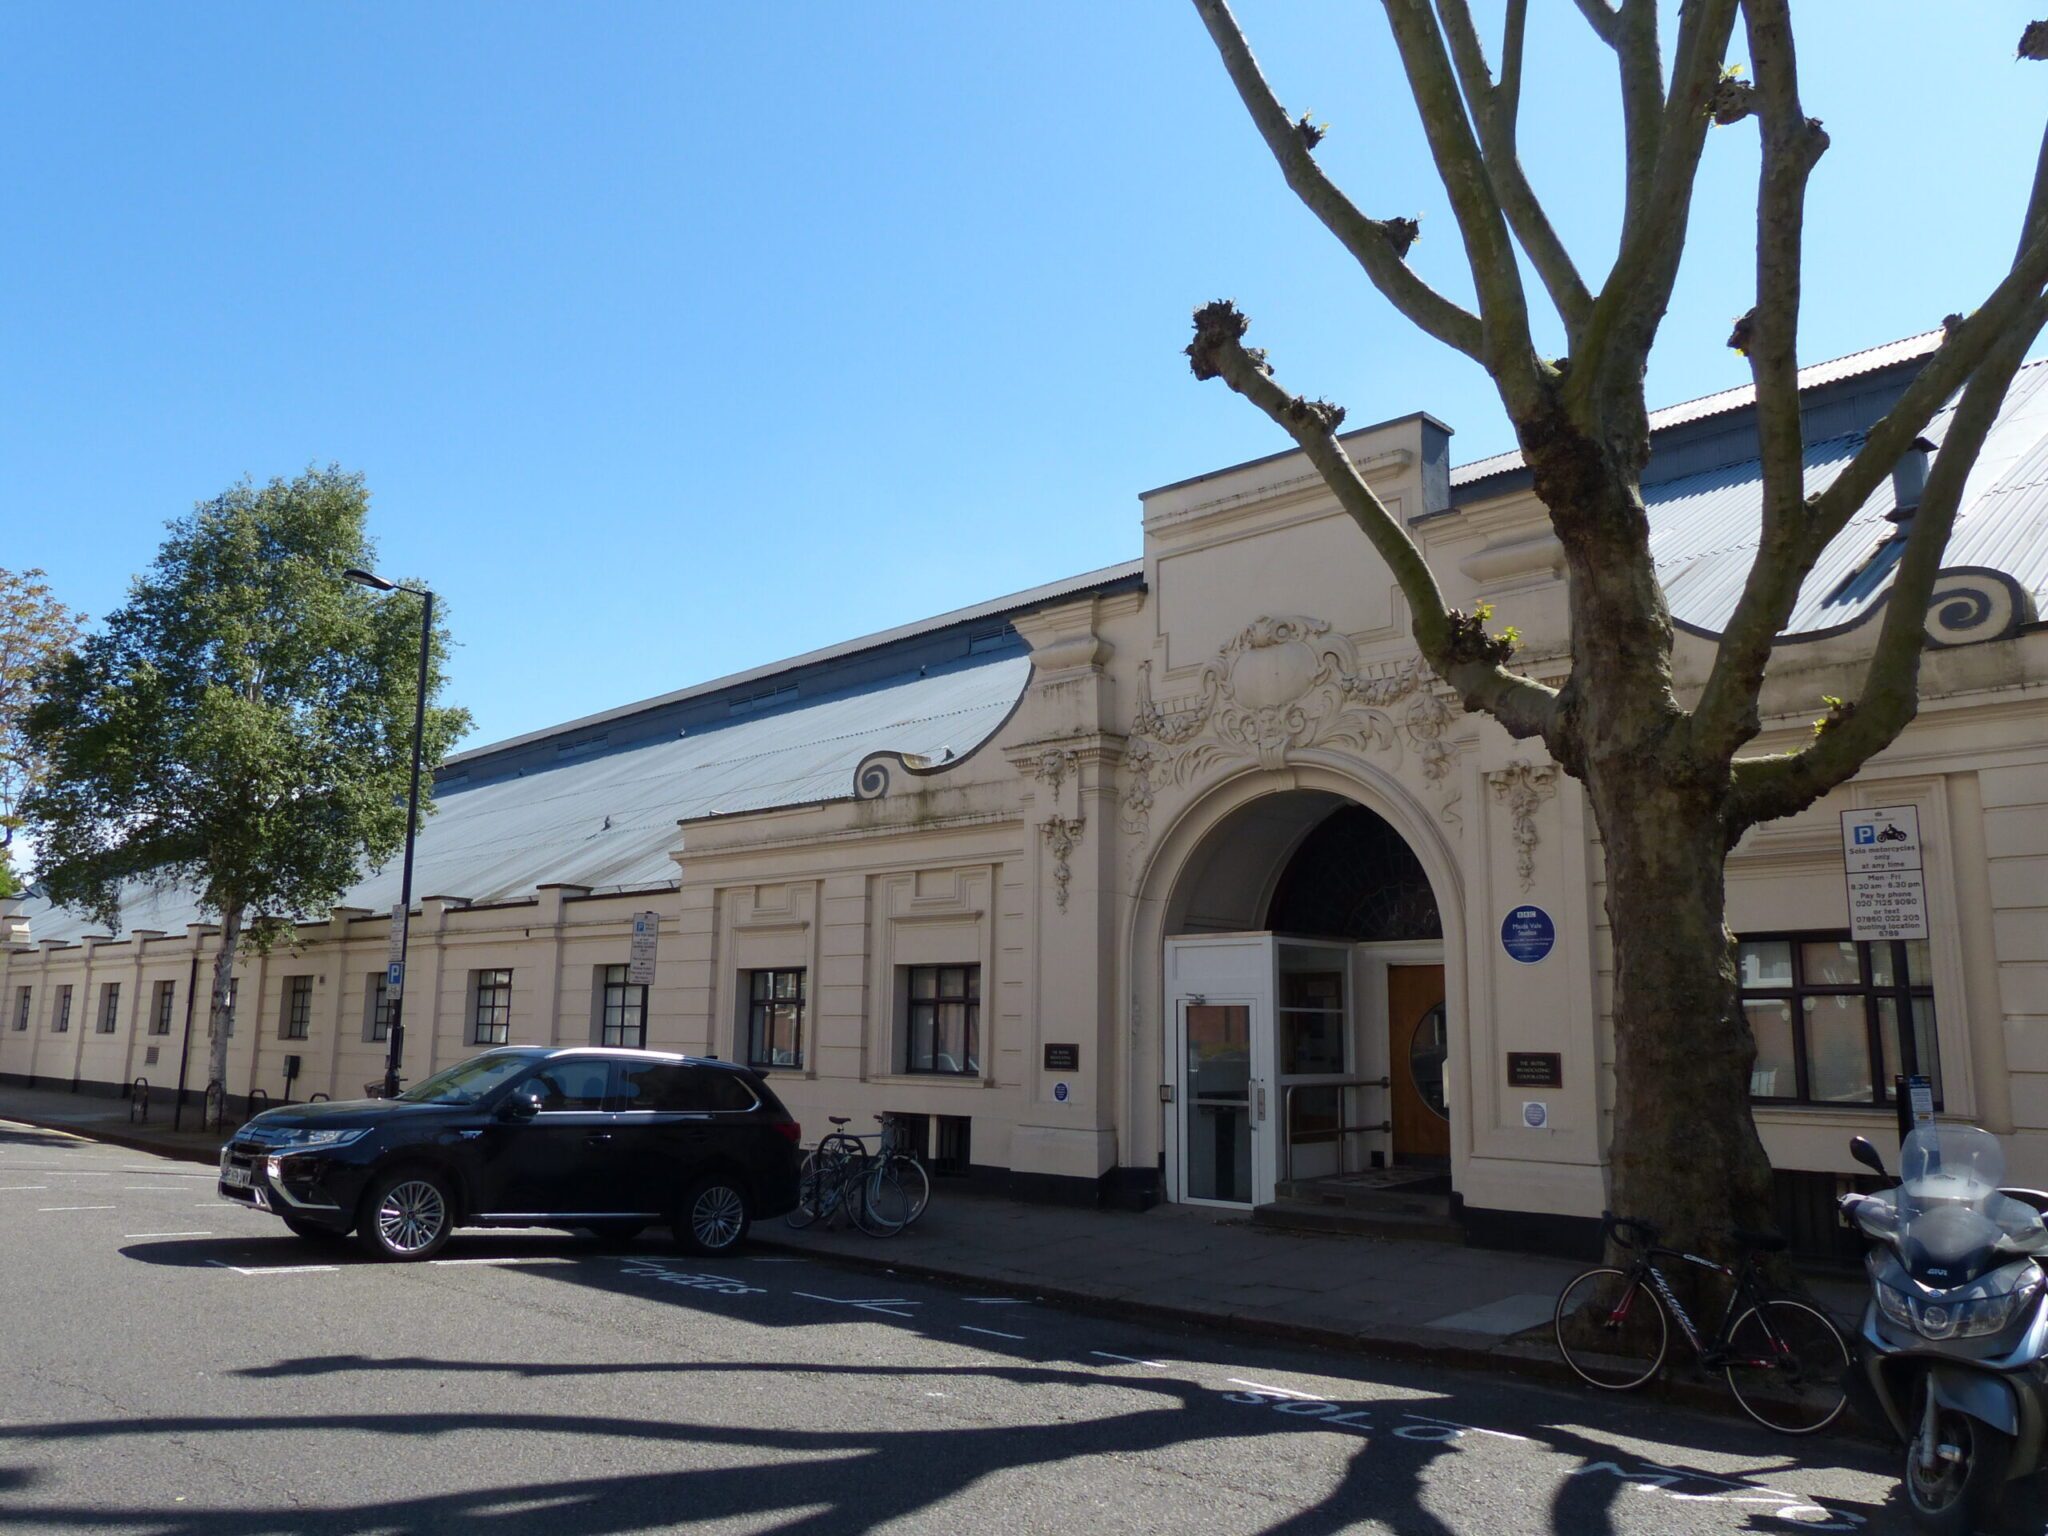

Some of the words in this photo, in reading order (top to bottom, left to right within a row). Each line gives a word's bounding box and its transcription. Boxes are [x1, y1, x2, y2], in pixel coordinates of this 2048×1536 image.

[1859, 828, 1872, 843] P
[1848, 847, 1866, 855] Solo
[1868, 845, 1916, 854] motorcycles
[1856, 899, 1872, 907] 020
[1857, 923, 1886, 931] quoting
[1222, 1390, 1465, 1441] SOLO
